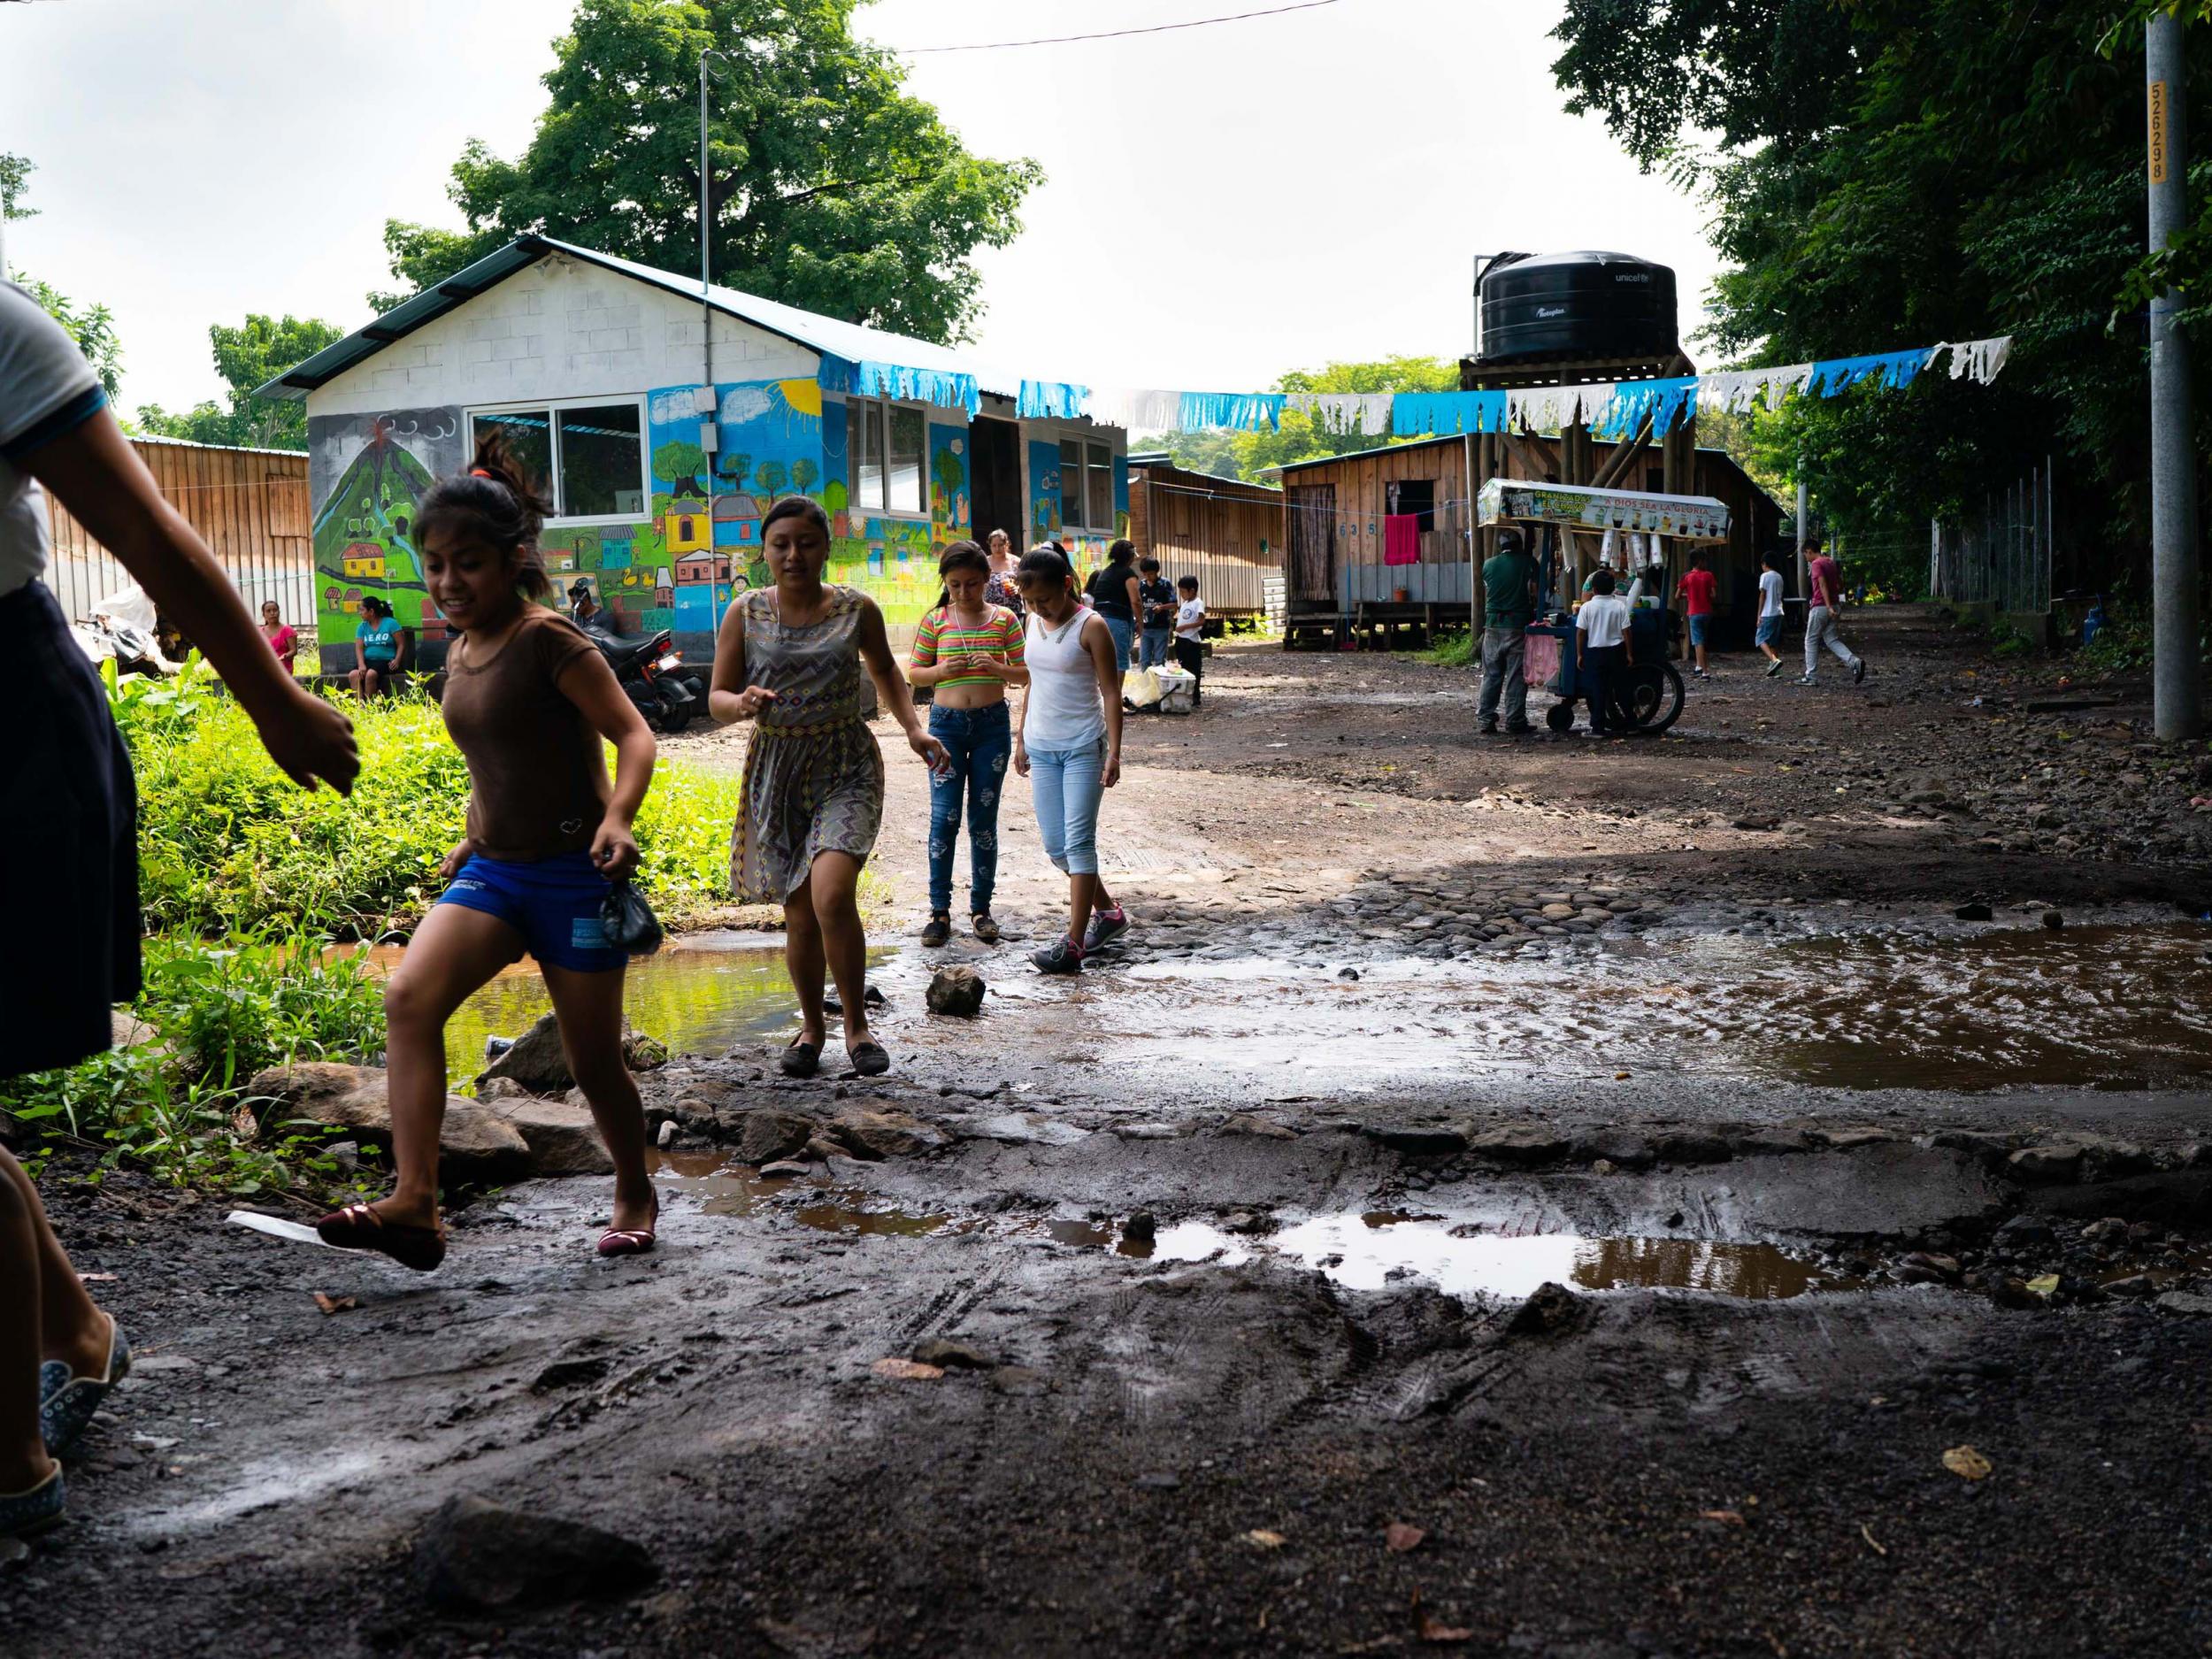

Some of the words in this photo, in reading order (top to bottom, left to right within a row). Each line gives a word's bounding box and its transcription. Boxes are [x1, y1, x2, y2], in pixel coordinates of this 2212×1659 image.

[2151, 84, 2162, 179] 526298
[1615, 272, 1640, 282] unicef
[1534, 490, 1592, 503] GRANIZADAS
[1542, 499, 1552, 509] EL
[1605, 498, 1611, 508] A
[1614, 498, 1637, 509] DIOS
[1640, 501, 1657, 511] SEA
[1674, 504, 1709, 515] GLORIA
